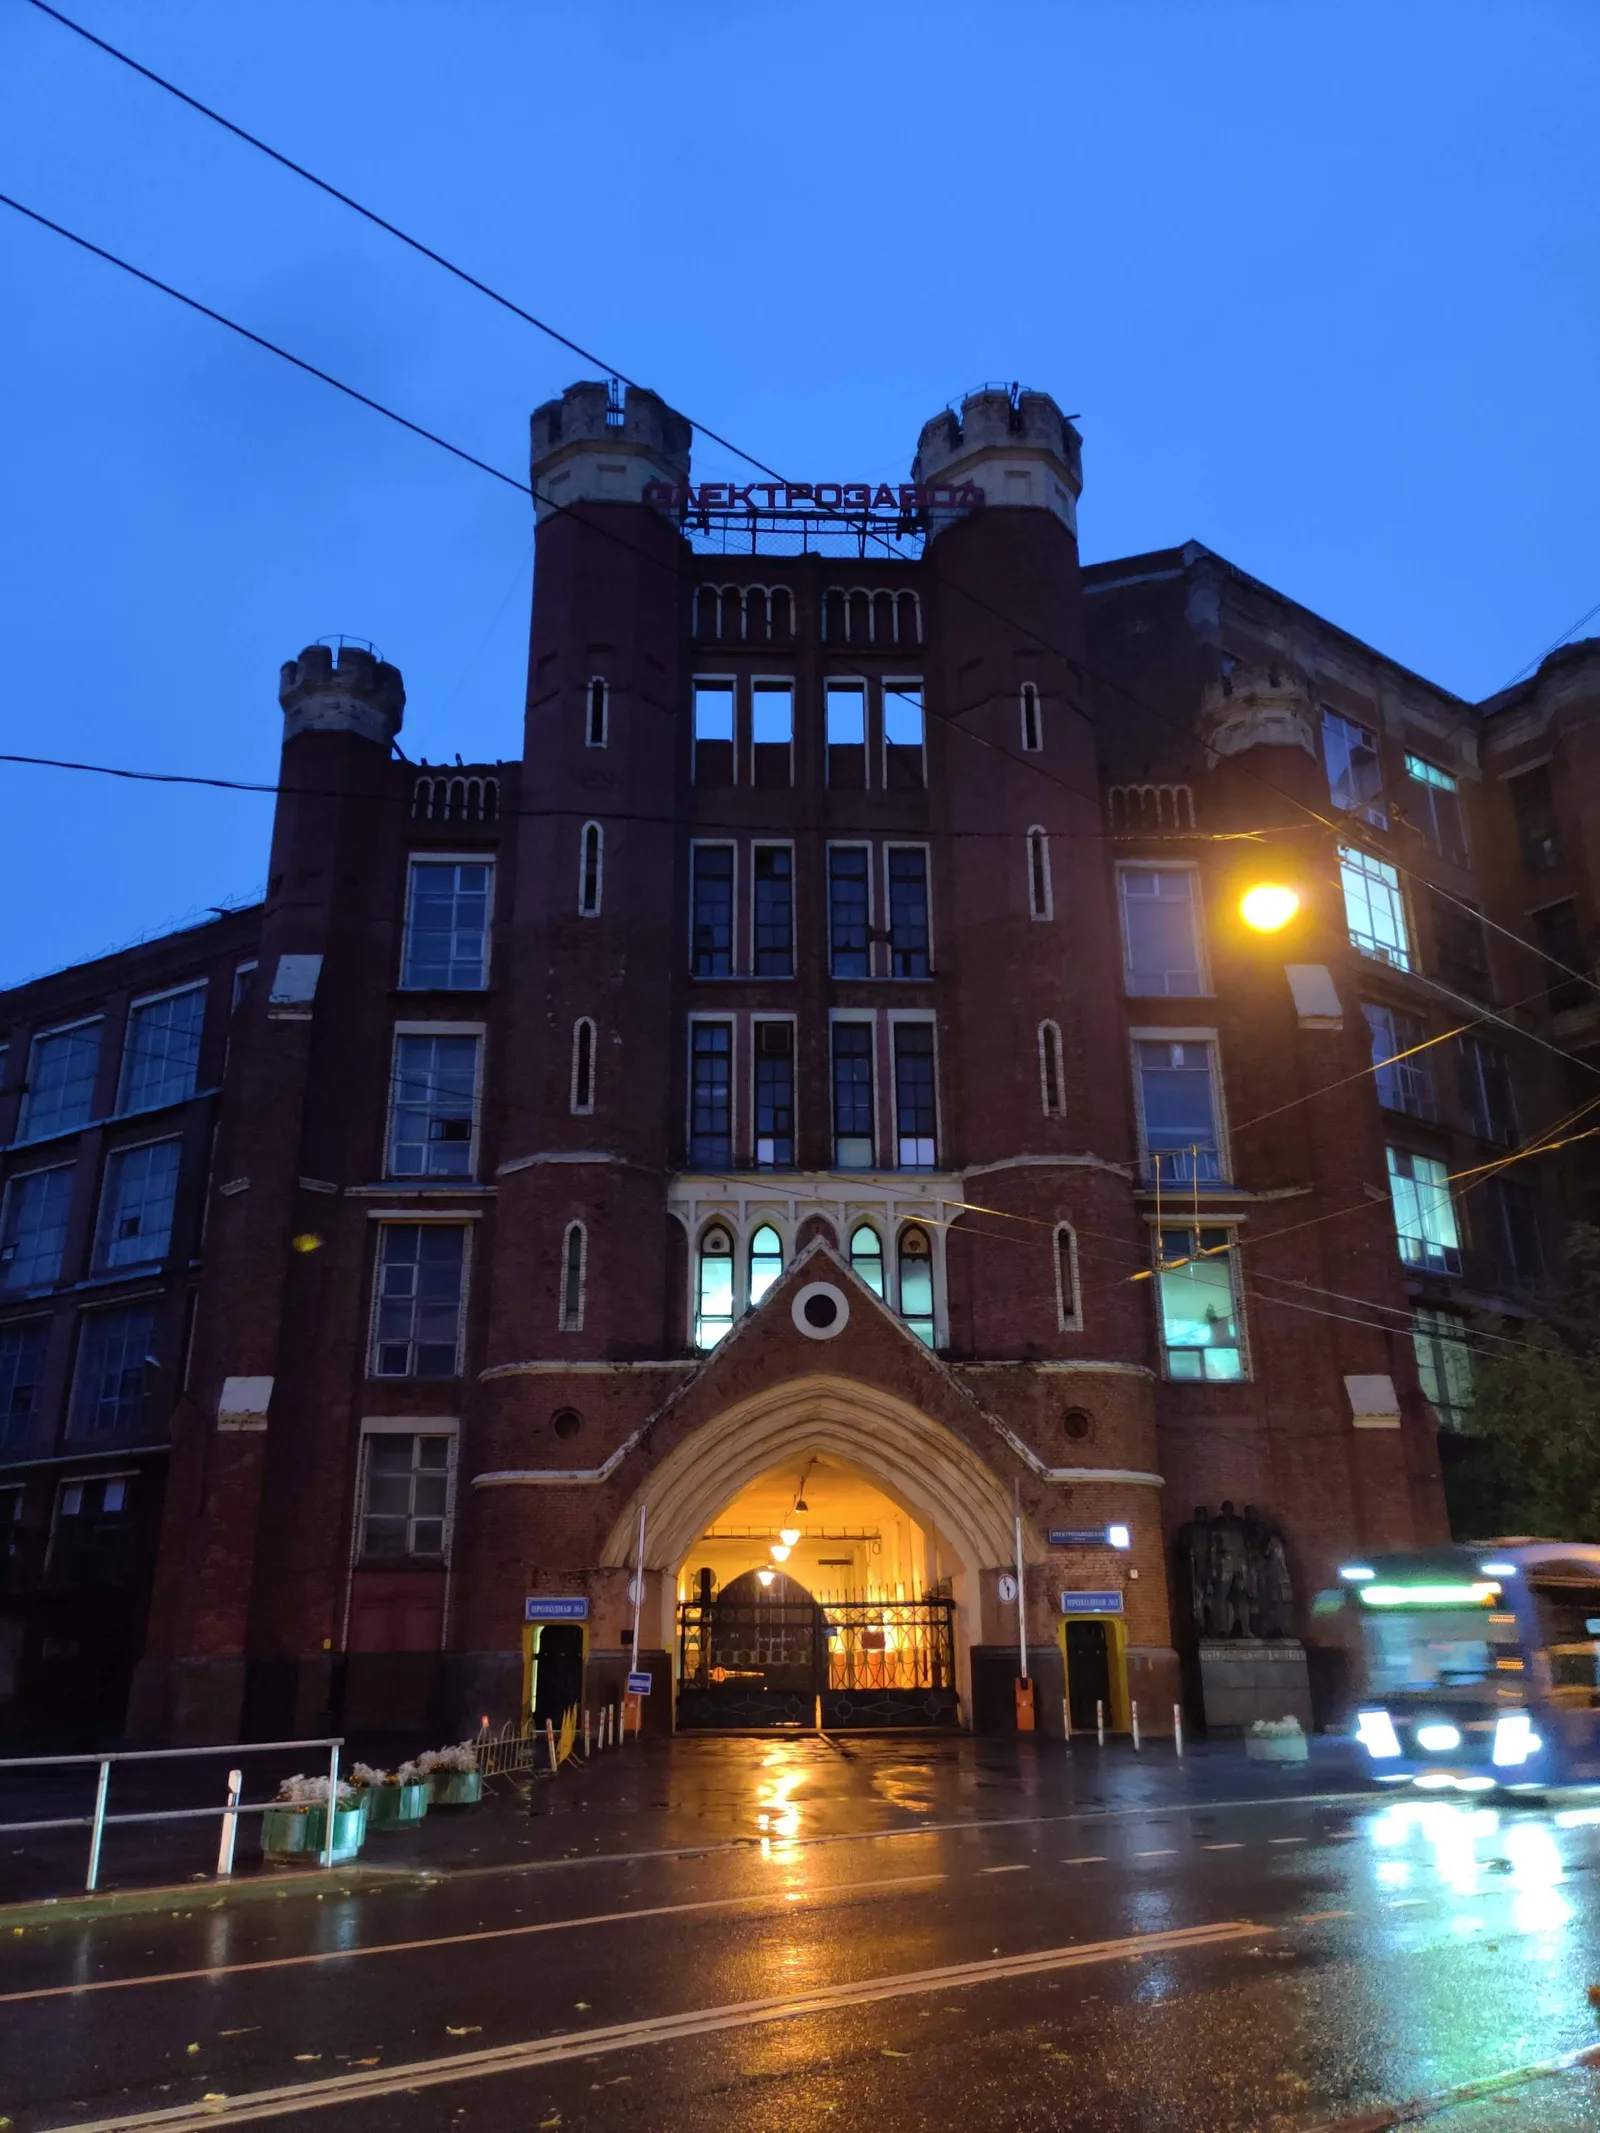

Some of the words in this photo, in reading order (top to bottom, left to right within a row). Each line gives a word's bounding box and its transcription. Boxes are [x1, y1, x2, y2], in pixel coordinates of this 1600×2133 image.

[642, 482, 985, 510] ЭЛЕКТРОЗАВОД
[1066, 1598, 1106, 1607] ПРОХОДНАЯ
[531, 1605, 572, 1613] ПРОХОДНАЯ
